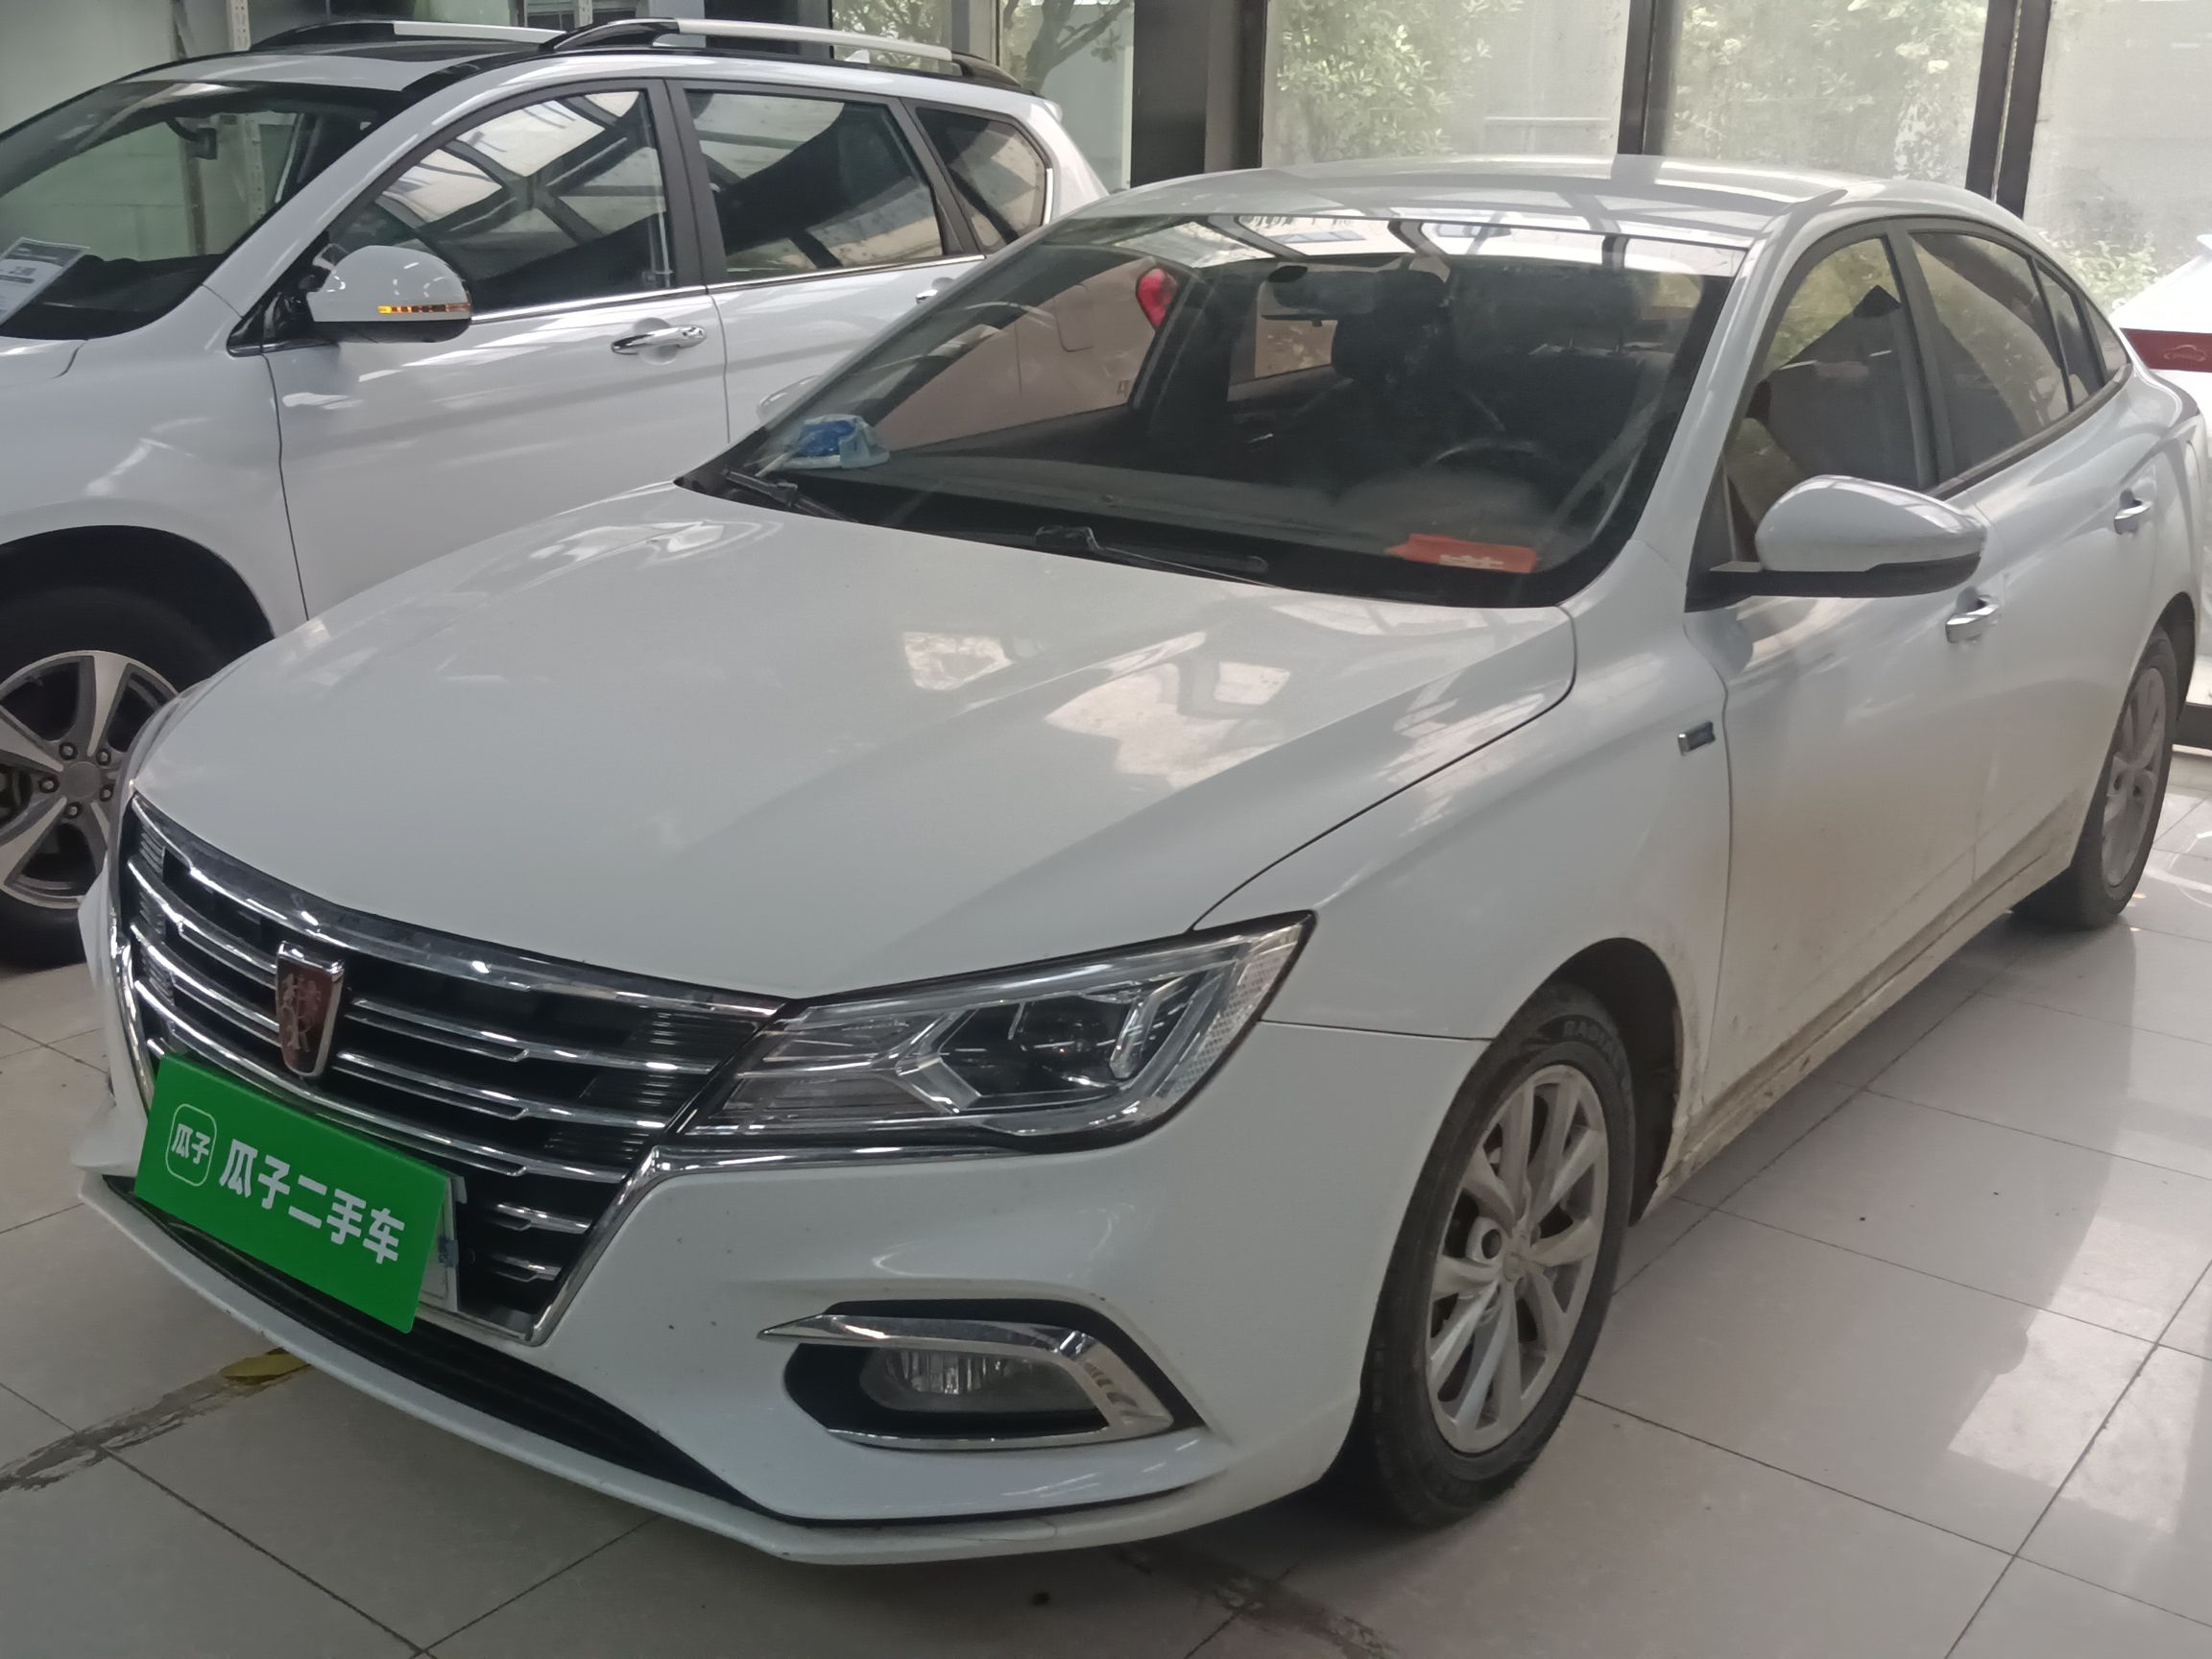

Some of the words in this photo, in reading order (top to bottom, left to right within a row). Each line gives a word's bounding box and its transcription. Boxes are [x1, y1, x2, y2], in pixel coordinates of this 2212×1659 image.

[171, 1123, 210, 1165] 瓜子
[219, 1139, 405, 1264] 瓜子二手车
